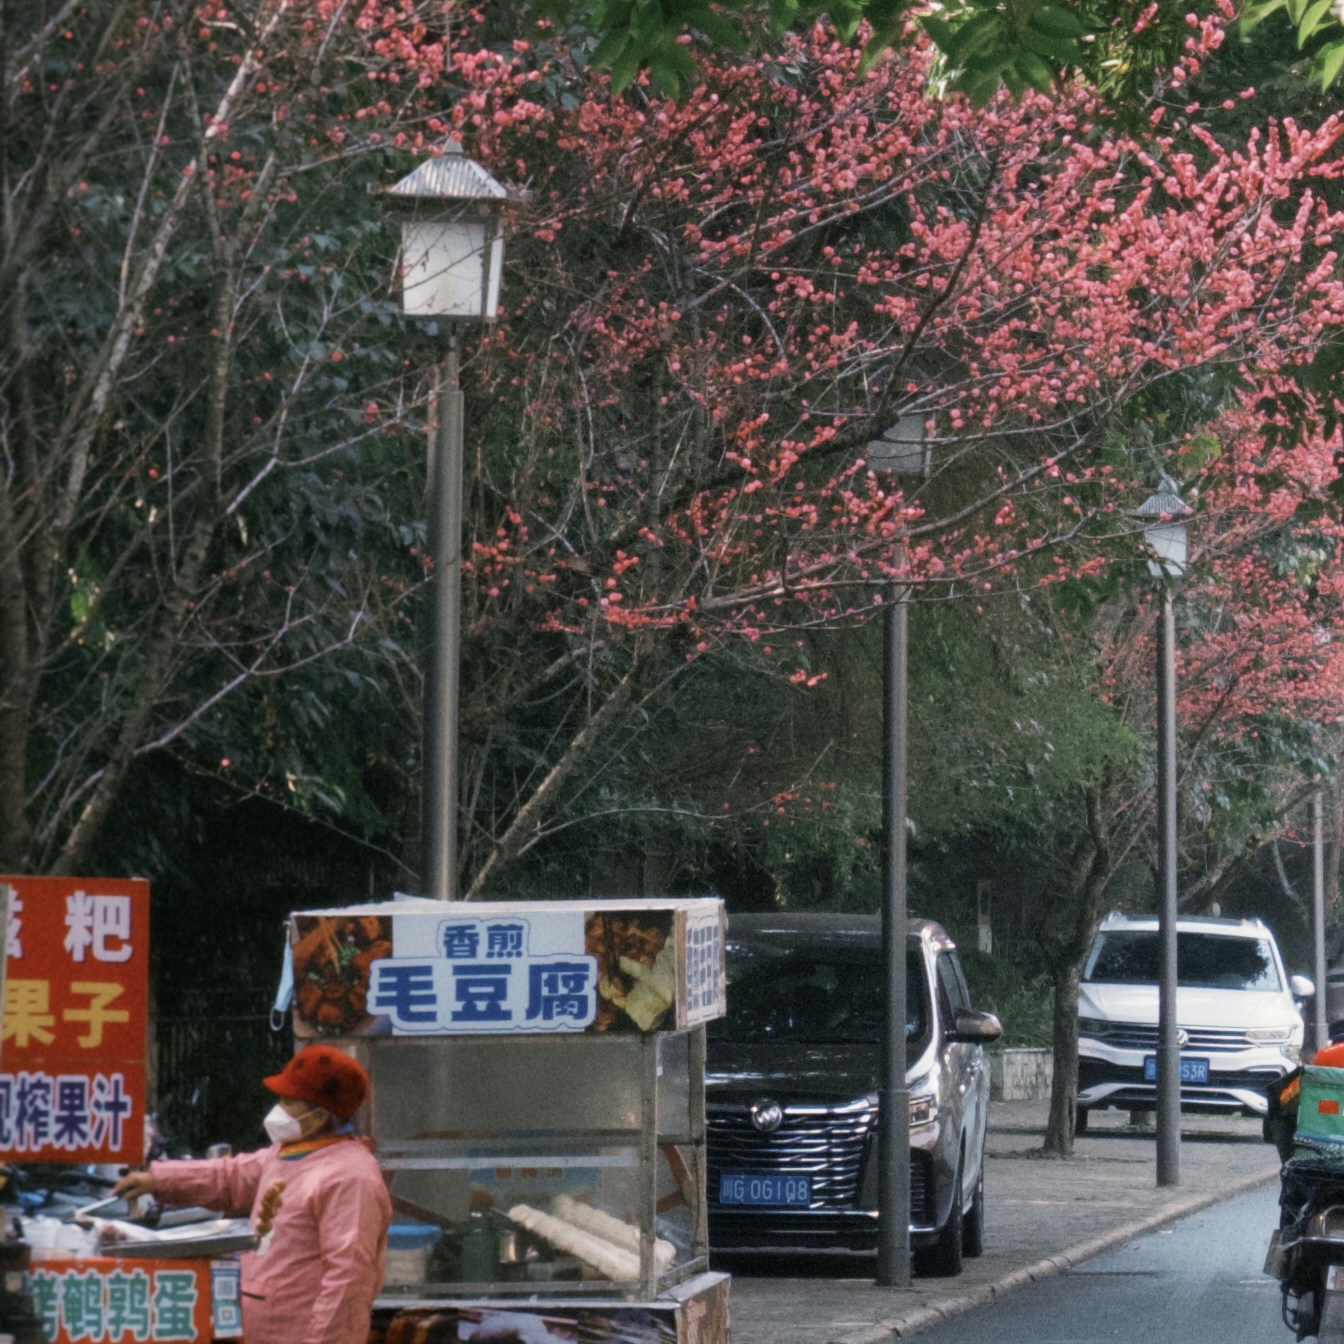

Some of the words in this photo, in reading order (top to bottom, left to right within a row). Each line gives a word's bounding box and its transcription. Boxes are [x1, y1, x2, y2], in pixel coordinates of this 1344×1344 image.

[443, 924, 524, 958] 香煎
[3, 979, 131, 1048] 果子
[375, 961, 590, 1024] 毛豆腐
